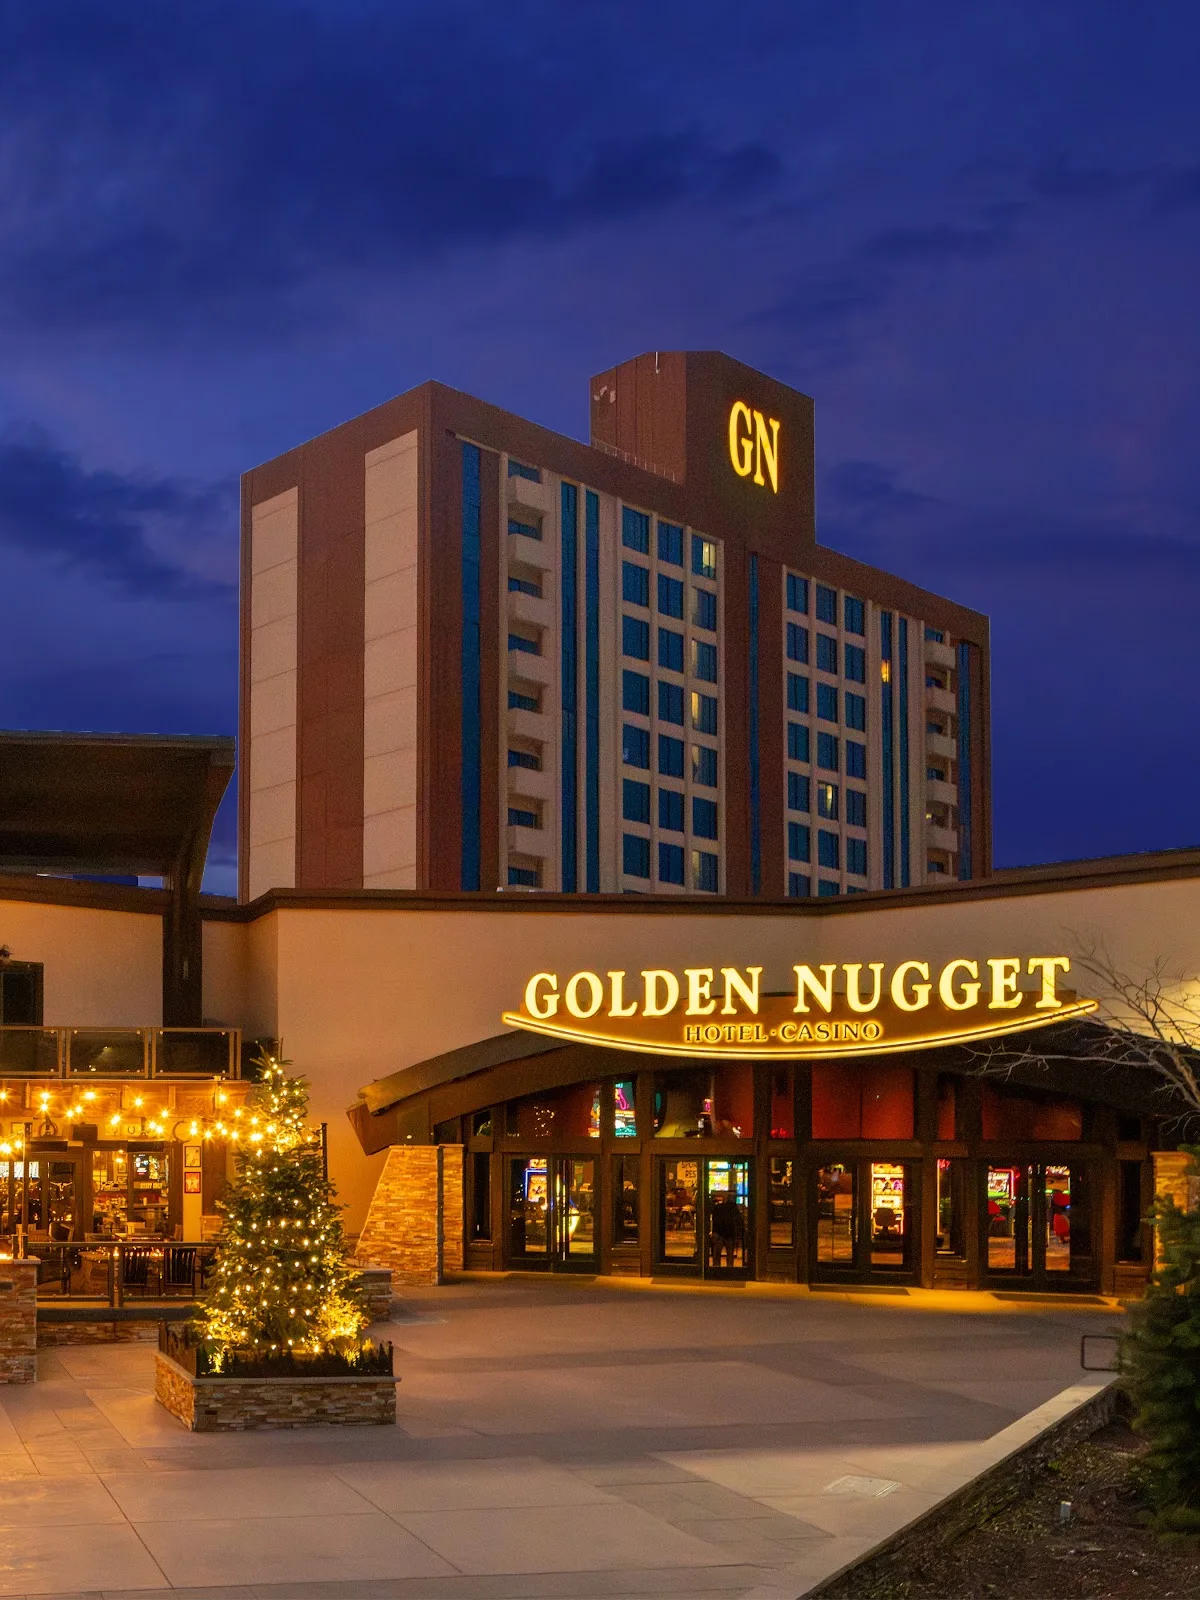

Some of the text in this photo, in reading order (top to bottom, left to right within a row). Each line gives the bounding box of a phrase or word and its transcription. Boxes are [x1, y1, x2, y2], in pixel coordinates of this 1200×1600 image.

[729, 400, 781, 494] GN
[525, 957, 1071, 1019] GOLDEN NUGGET
[685, 1022, 881, 1041] HOTEL CASINO
